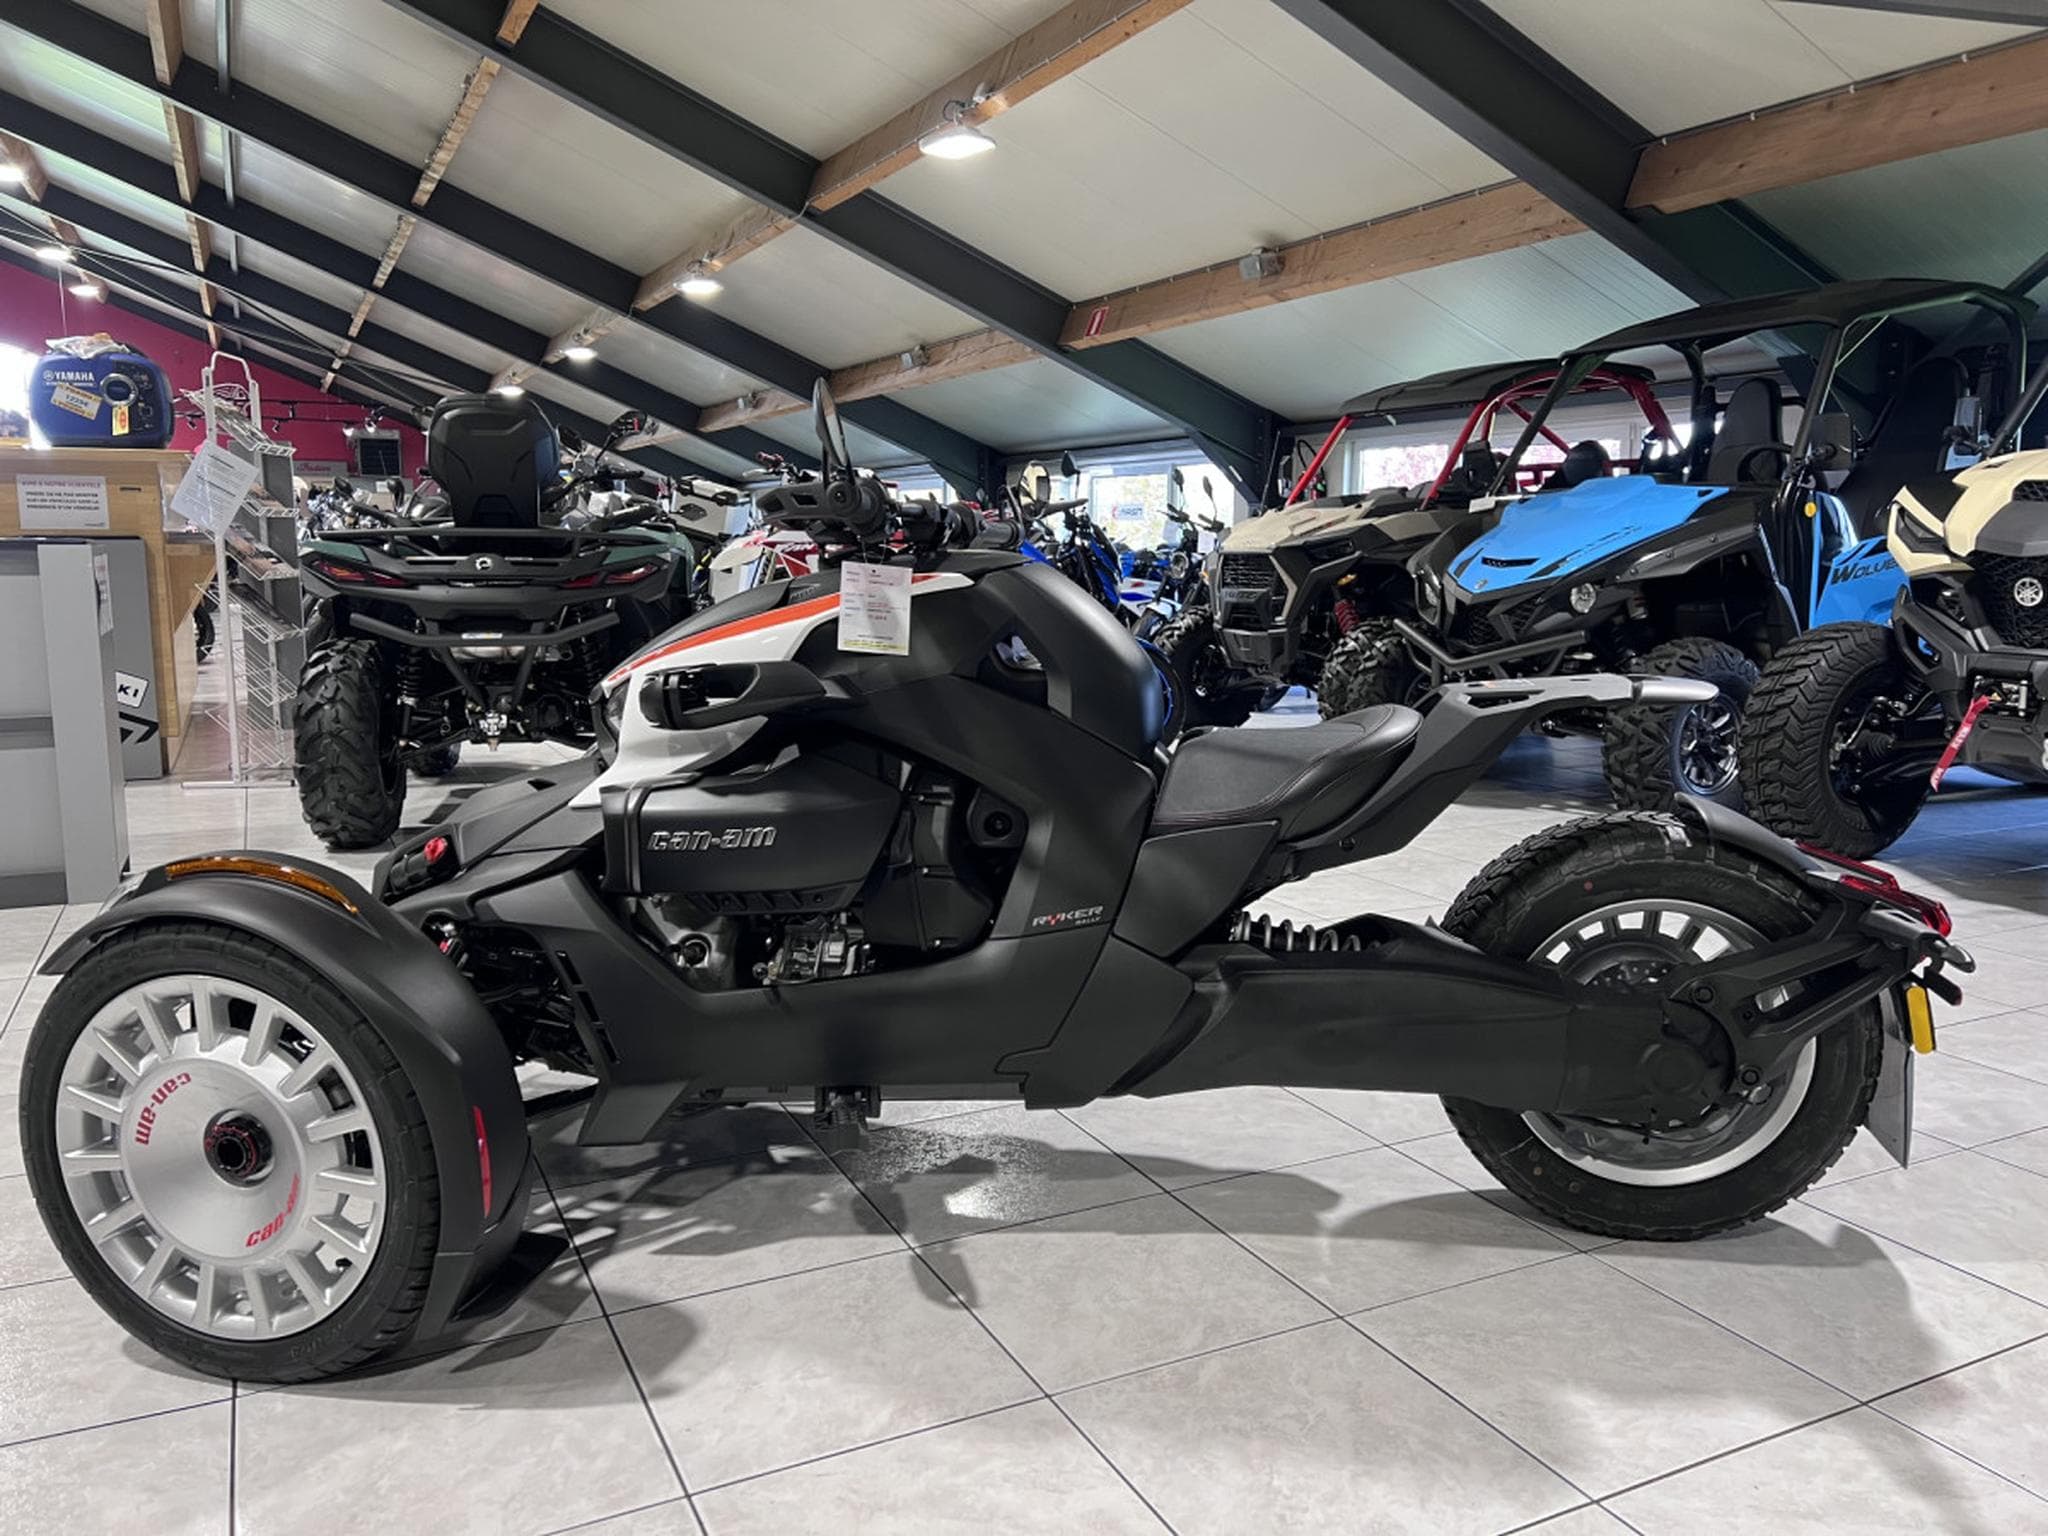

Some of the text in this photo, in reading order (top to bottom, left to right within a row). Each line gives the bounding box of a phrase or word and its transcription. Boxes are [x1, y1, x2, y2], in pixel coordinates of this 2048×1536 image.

[54, 371, 95, 382] YAMAHA
[648, 826, 777, 851] can-am
[1032, 905, 1104, 927] RYKER
[135, 1072, 192, 1146] can-am
